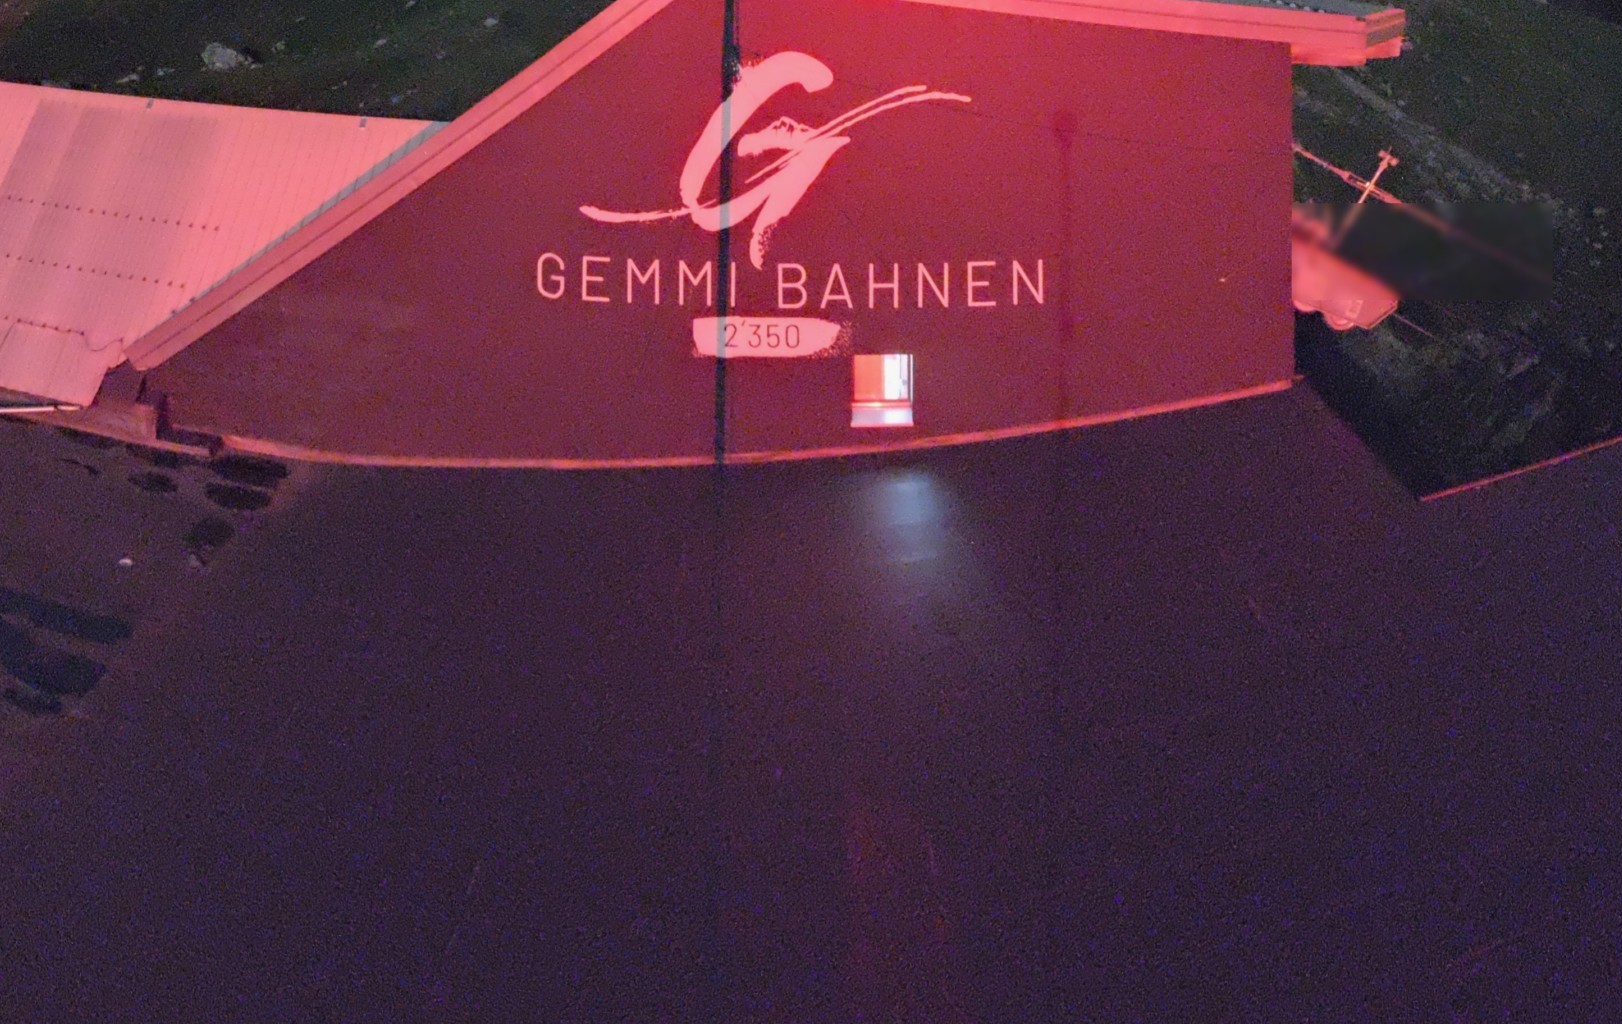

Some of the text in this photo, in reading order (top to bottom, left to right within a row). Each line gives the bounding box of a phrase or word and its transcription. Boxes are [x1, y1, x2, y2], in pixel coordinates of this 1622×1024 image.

[536, 251, 1045, 310] GEMMI BAHNEN
[723, 319, 801, 349] 2'350
